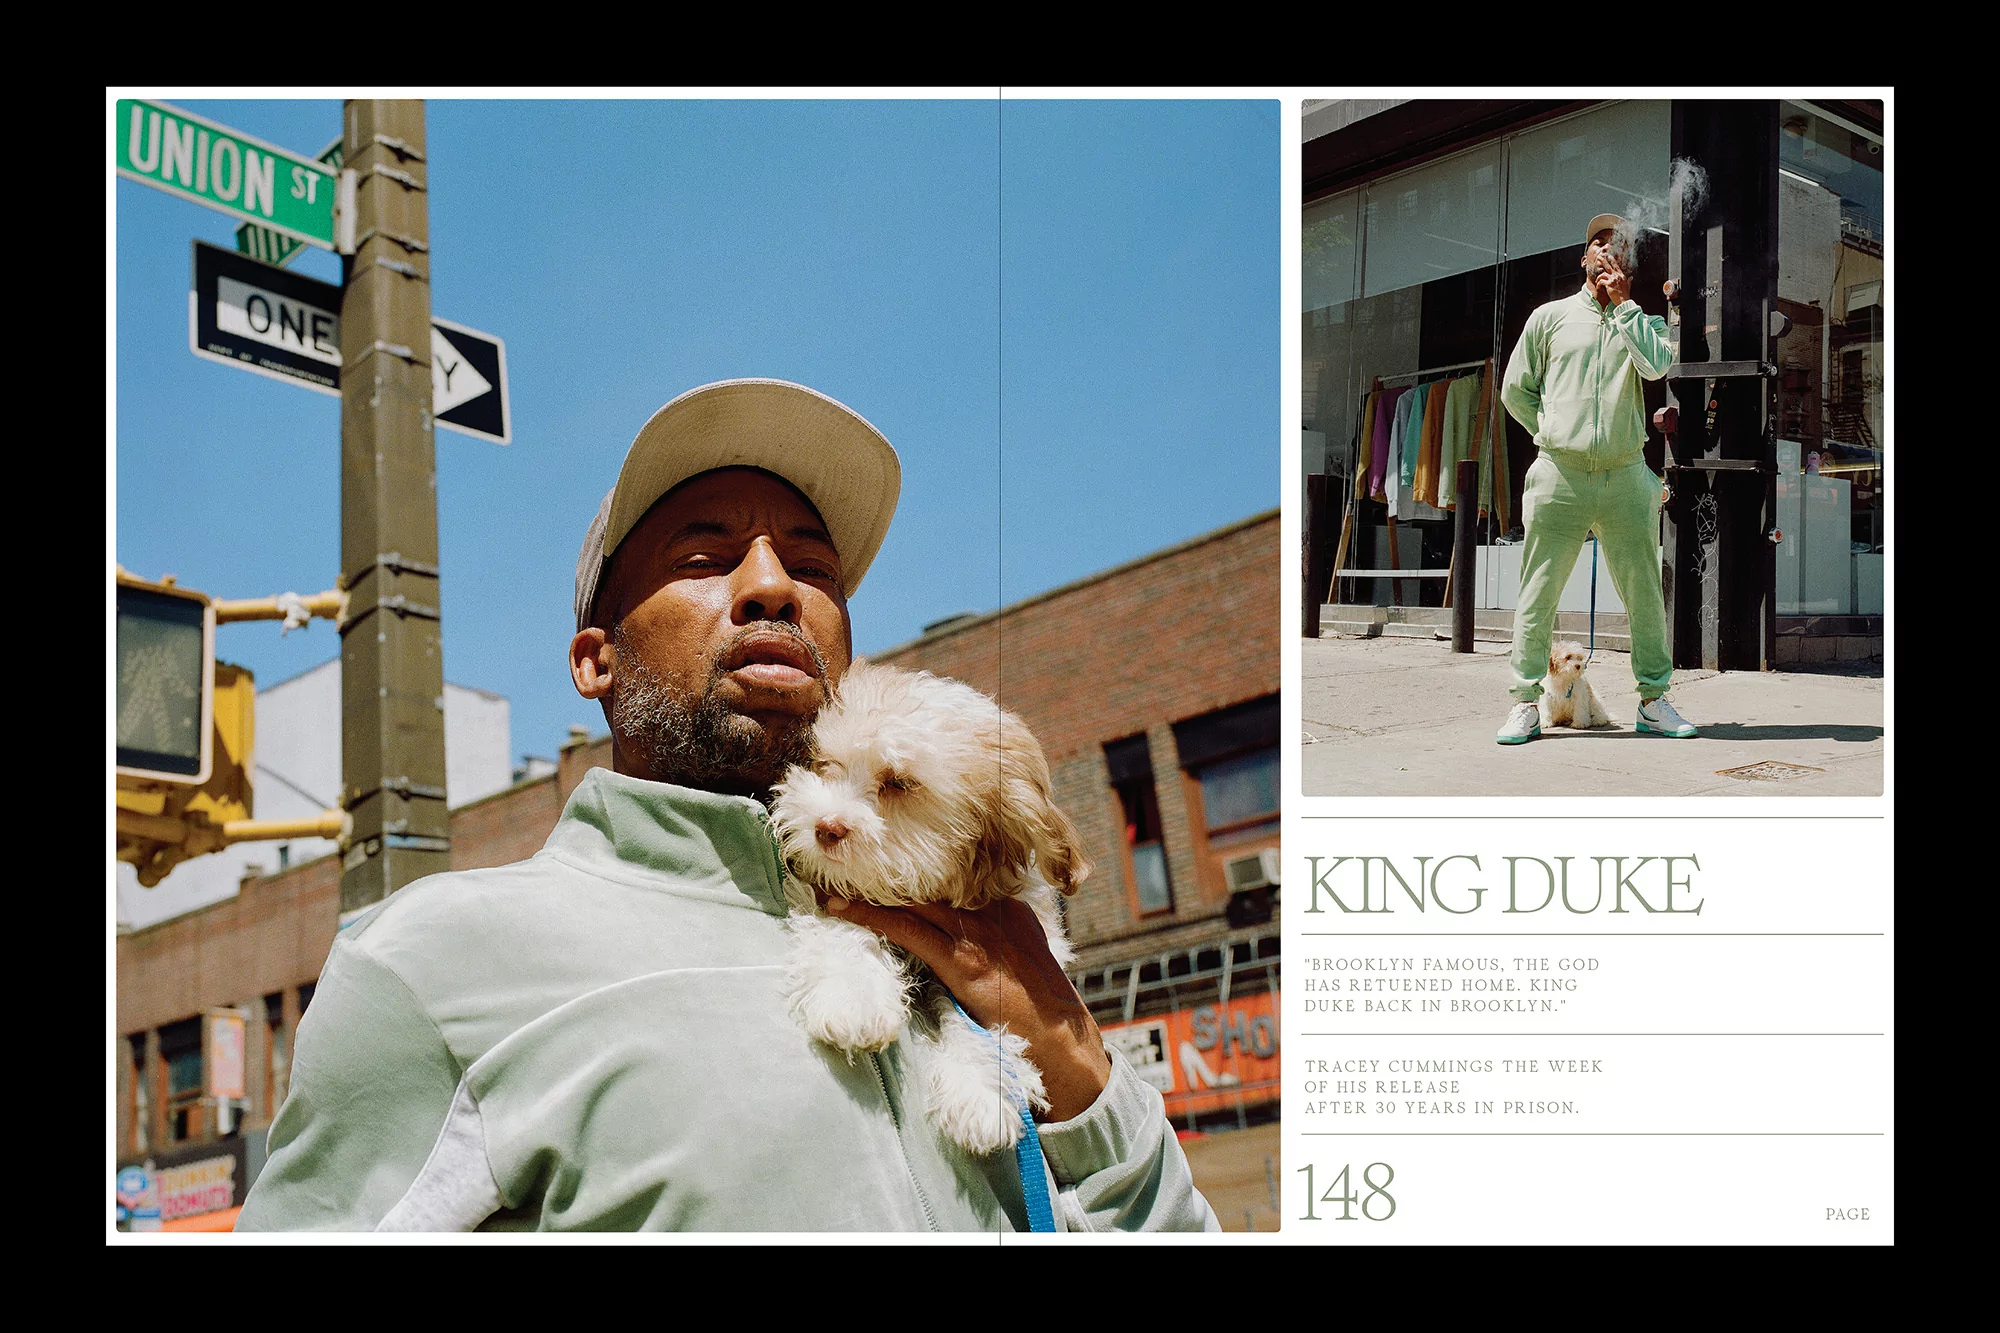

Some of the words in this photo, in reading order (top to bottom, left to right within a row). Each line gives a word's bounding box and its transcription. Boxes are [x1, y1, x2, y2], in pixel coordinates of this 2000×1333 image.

[128, 104, 274, 217] UNION
[291, 166, 320, 204] ST
[246, 293, 334, 355] ONE
[1191, 1004, 1276, 1059] SHO
